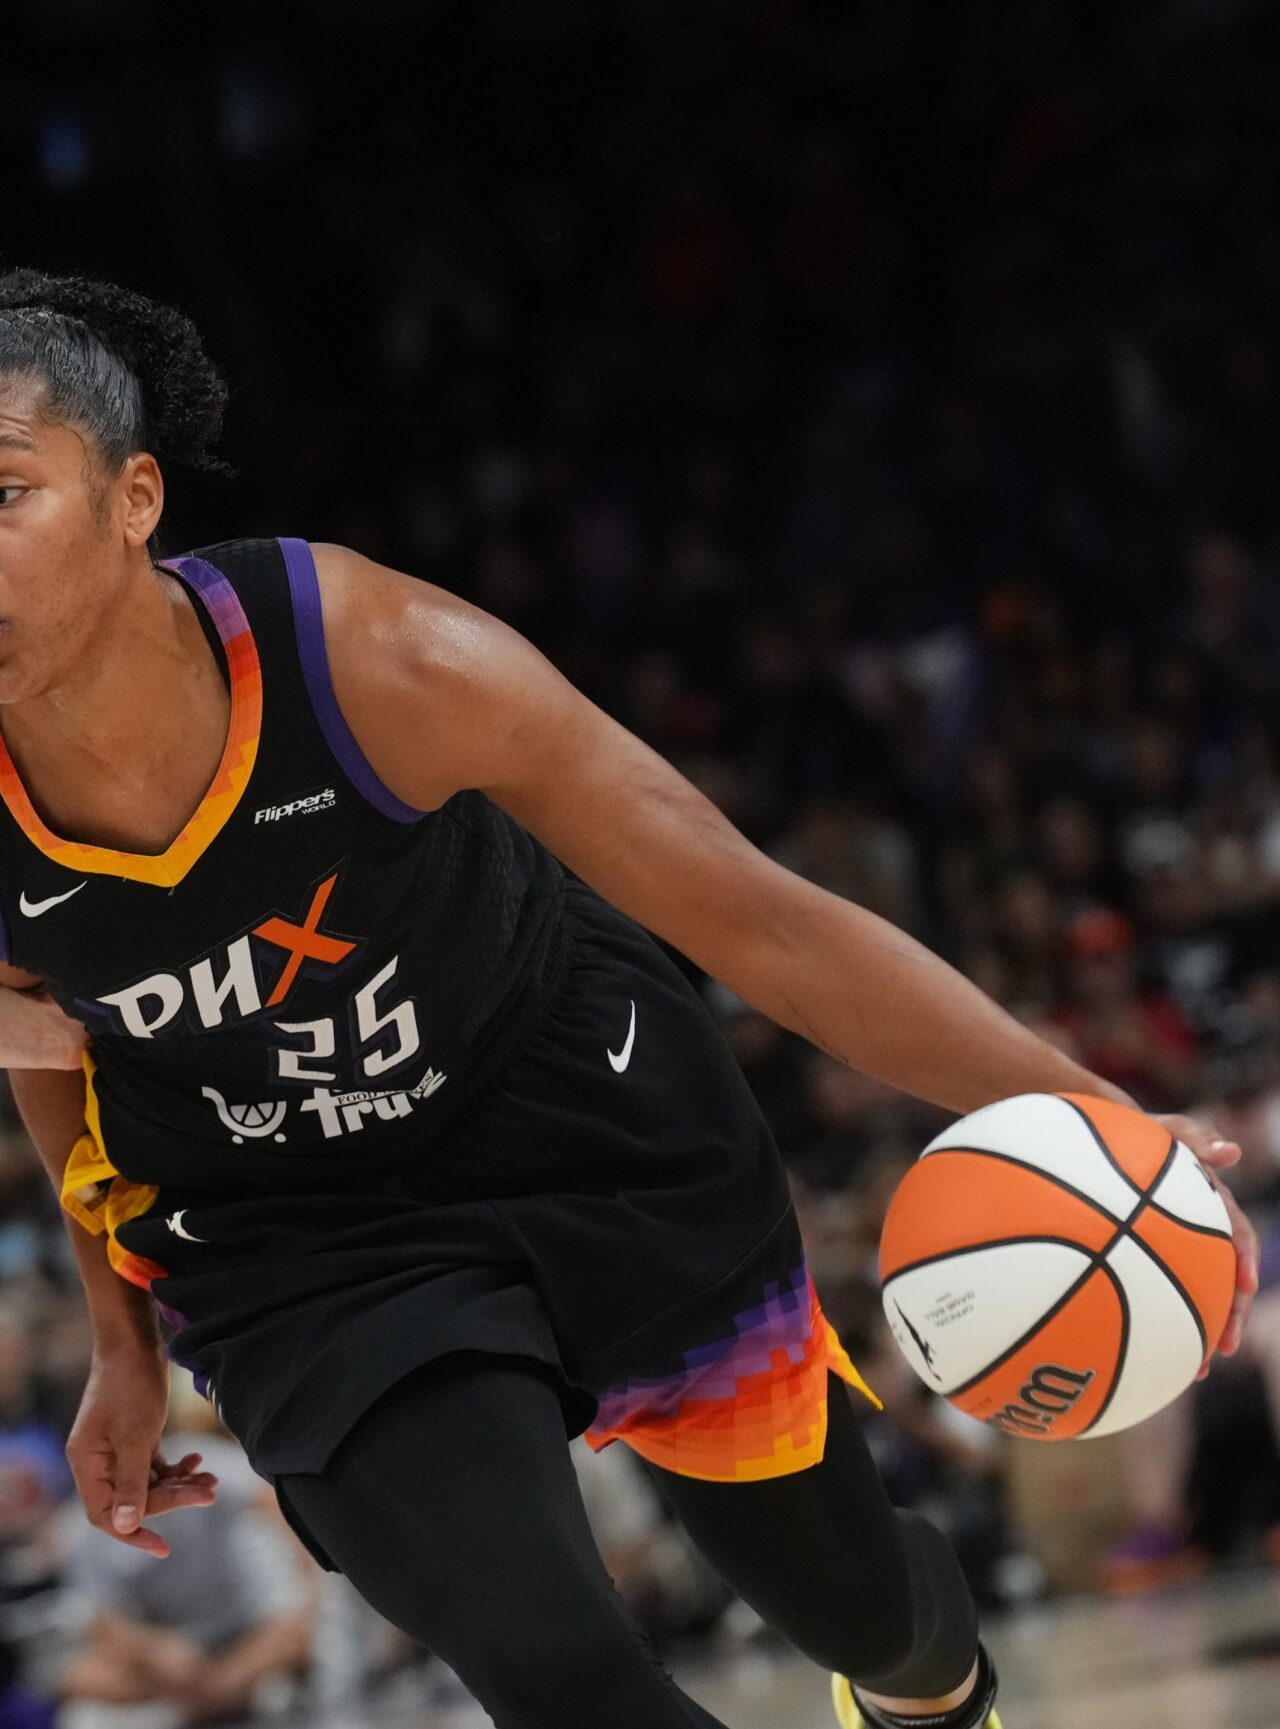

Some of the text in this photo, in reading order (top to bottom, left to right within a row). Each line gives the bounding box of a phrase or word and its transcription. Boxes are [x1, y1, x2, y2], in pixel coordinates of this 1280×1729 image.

[301, 799, 336, 815] WORLD
[96, 873, 358, 1039] PHX
[273, 954, 420, 1081] 25
